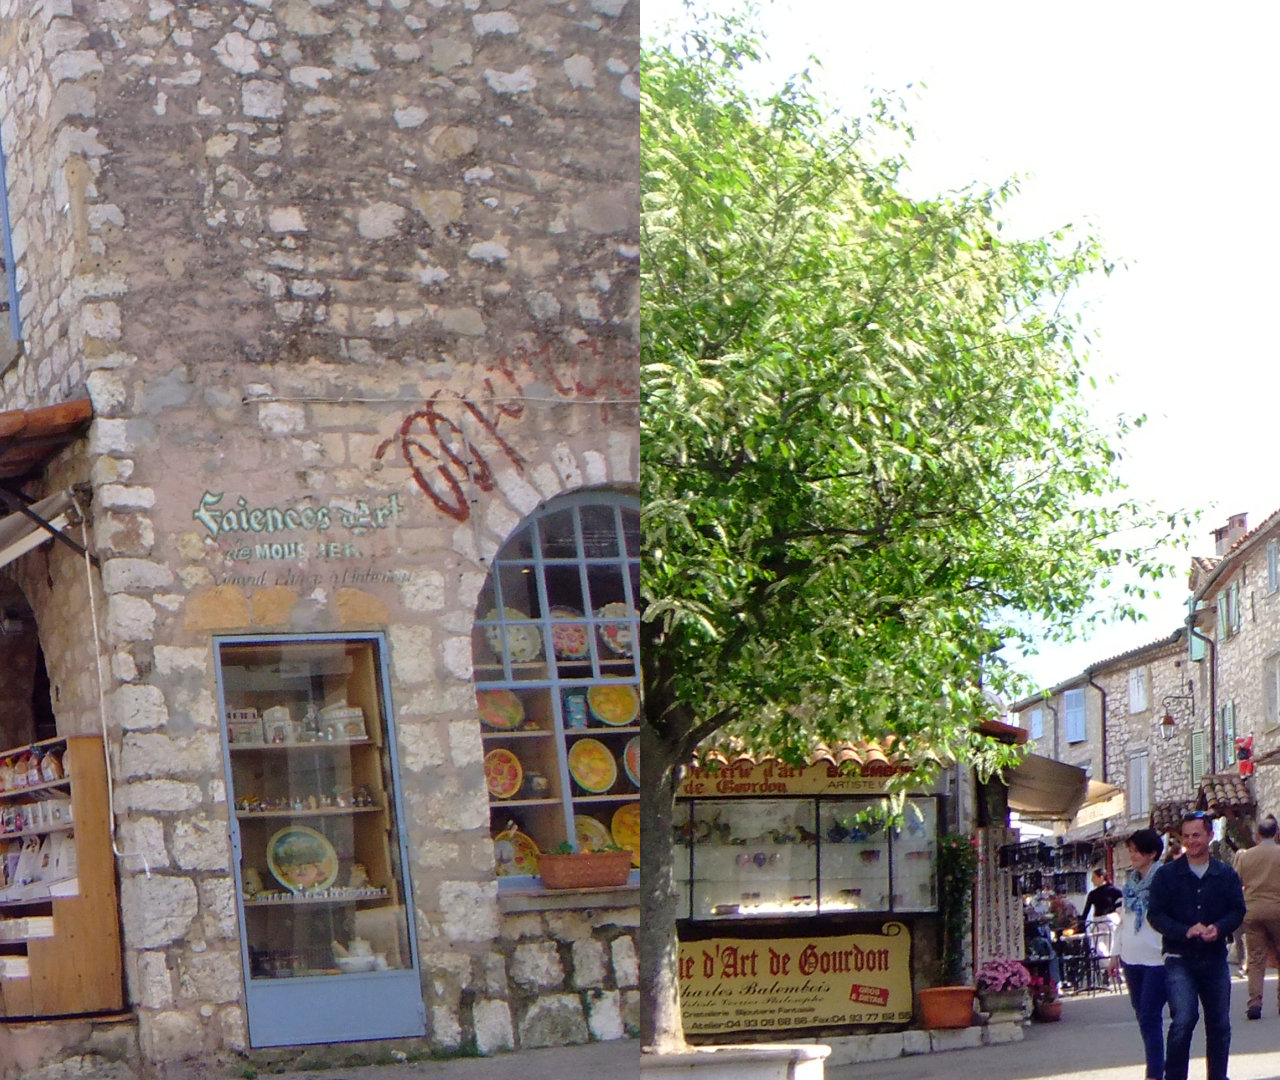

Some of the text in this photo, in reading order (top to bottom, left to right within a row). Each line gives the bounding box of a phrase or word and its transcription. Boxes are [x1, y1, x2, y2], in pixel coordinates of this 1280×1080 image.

[683, 777, 788, 794] de Gourdon
[827, 780, 874, 789] ARTISTE
[703, 943, 758, 979] d'Art
[768, 946, 791, 976] de
[799, 943, 890, 976] Gourdon
[744, 1019, 758, 1027] 93
[849, 1014, 863, 1022] 93
[866, 1013, 879, 1021] 77
